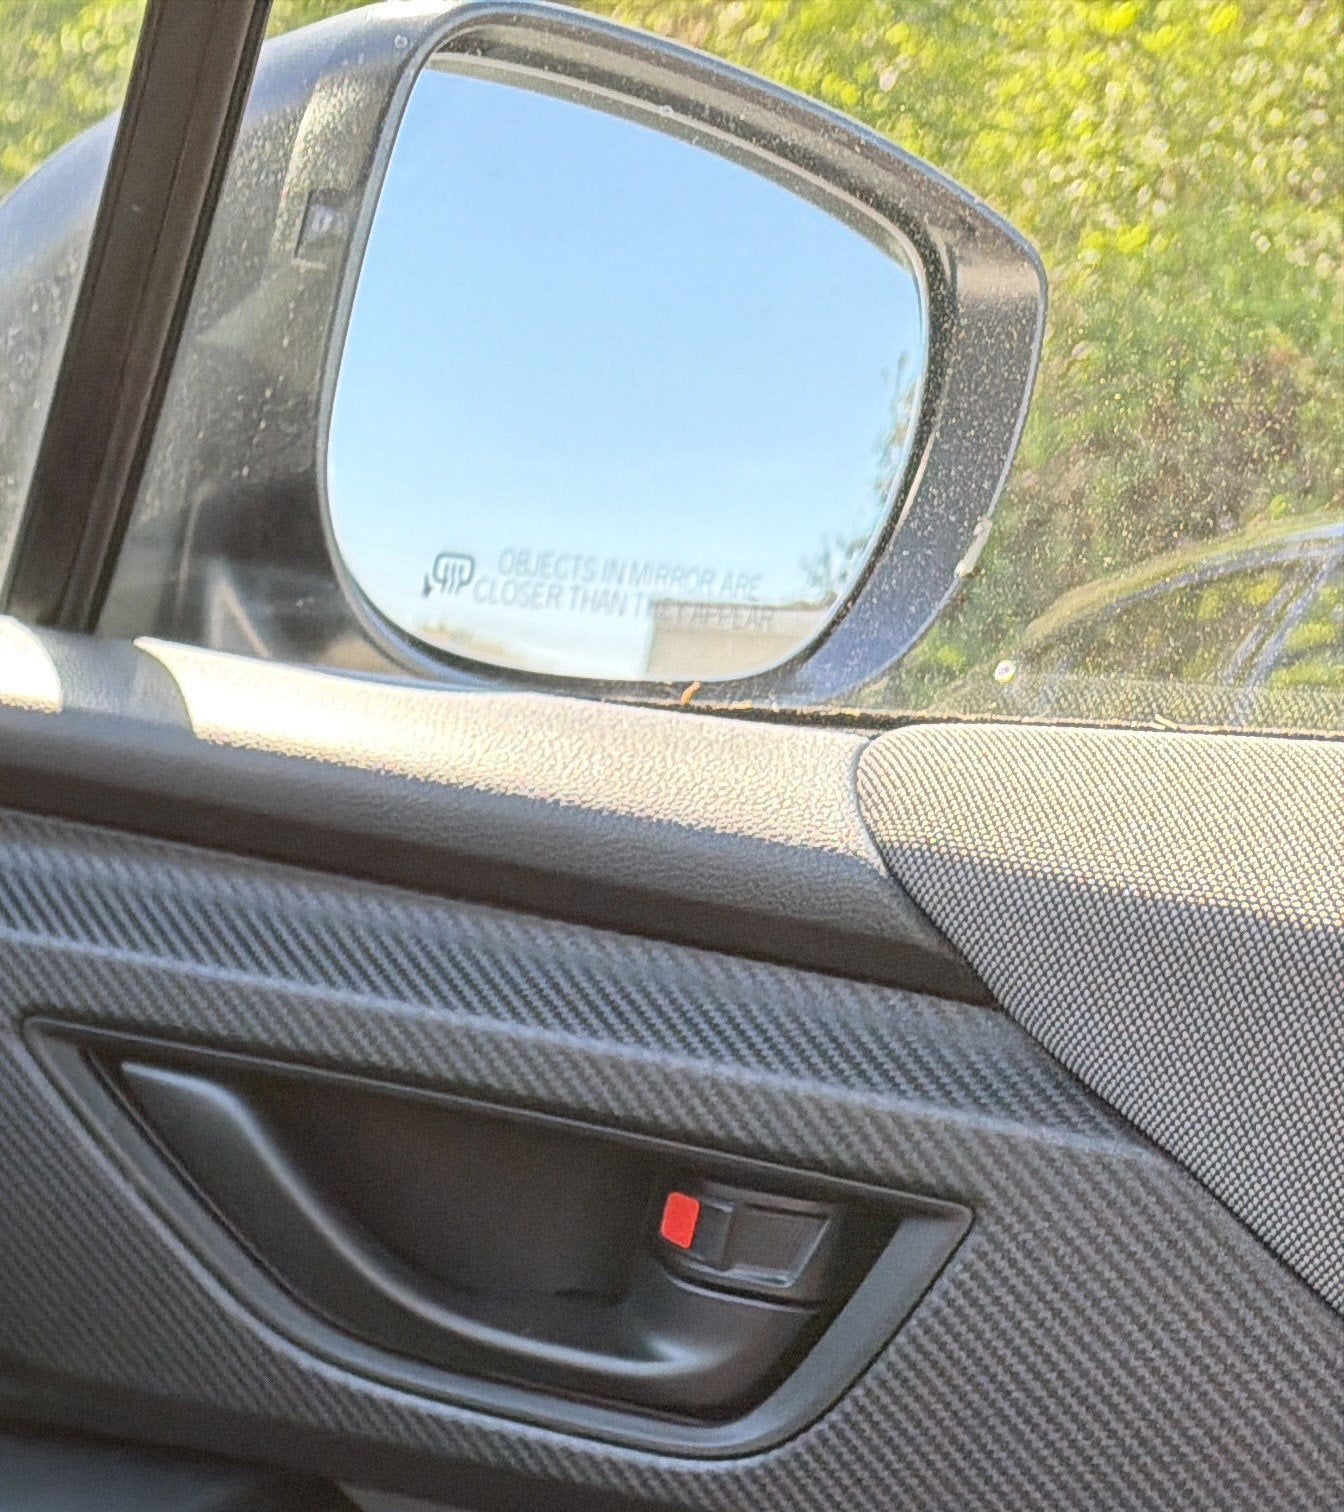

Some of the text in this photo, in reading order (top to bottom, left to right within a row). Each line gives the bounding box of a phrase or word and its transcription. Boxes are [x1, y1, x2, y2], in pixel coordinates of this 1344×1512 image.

[472, 576, 564, 612] CLOSER
[568, 585, 629, 618] THAN
[497, 545, 764, 601] OBJECTS IN MIRROR ARE
